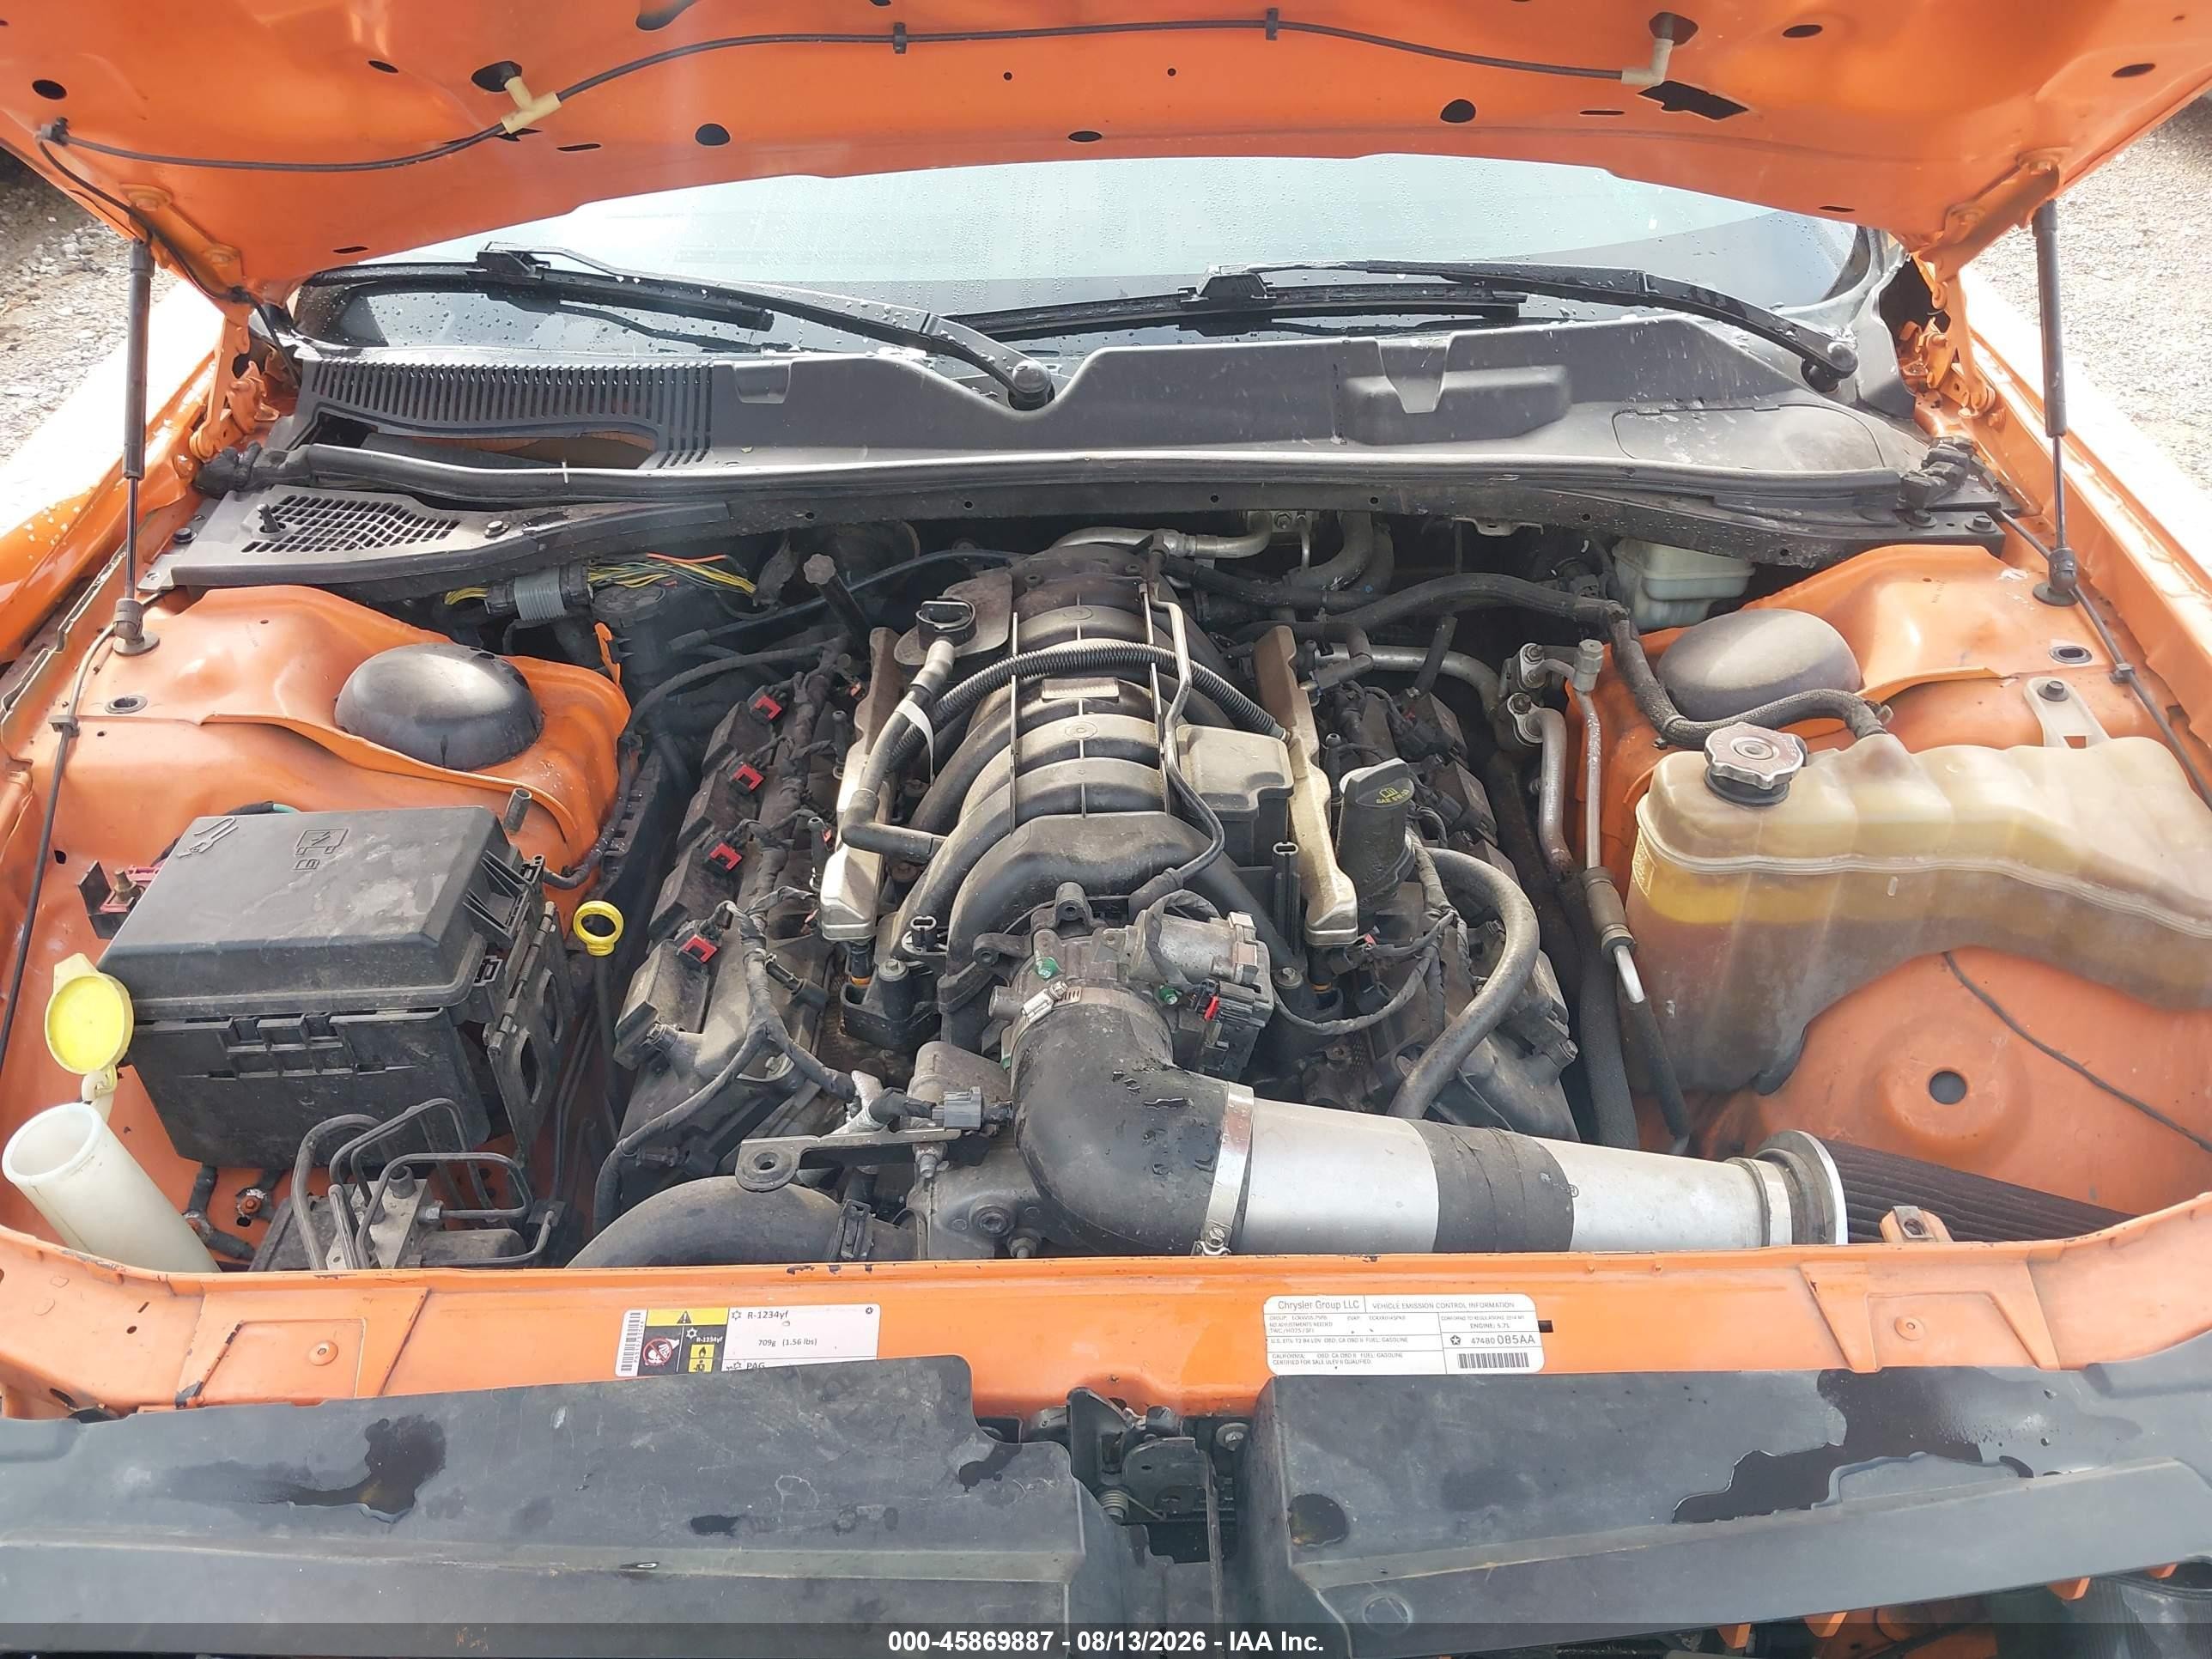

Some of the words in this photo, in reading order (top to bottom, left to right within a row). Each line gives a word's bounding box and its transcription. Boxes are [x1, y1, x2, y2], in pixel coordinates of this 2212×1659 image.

[1278, 1300, 1313, 1311] Chrysler
[1315, 1300, 1341, 1311] Group
[1343, 1300, 1360, 1310] LLC
[747, 1310, 789, 1320] R-1234yf
[758, 1339, 776, 1347] 709g
[1497, 1334, 1536, 1345] 085AA
